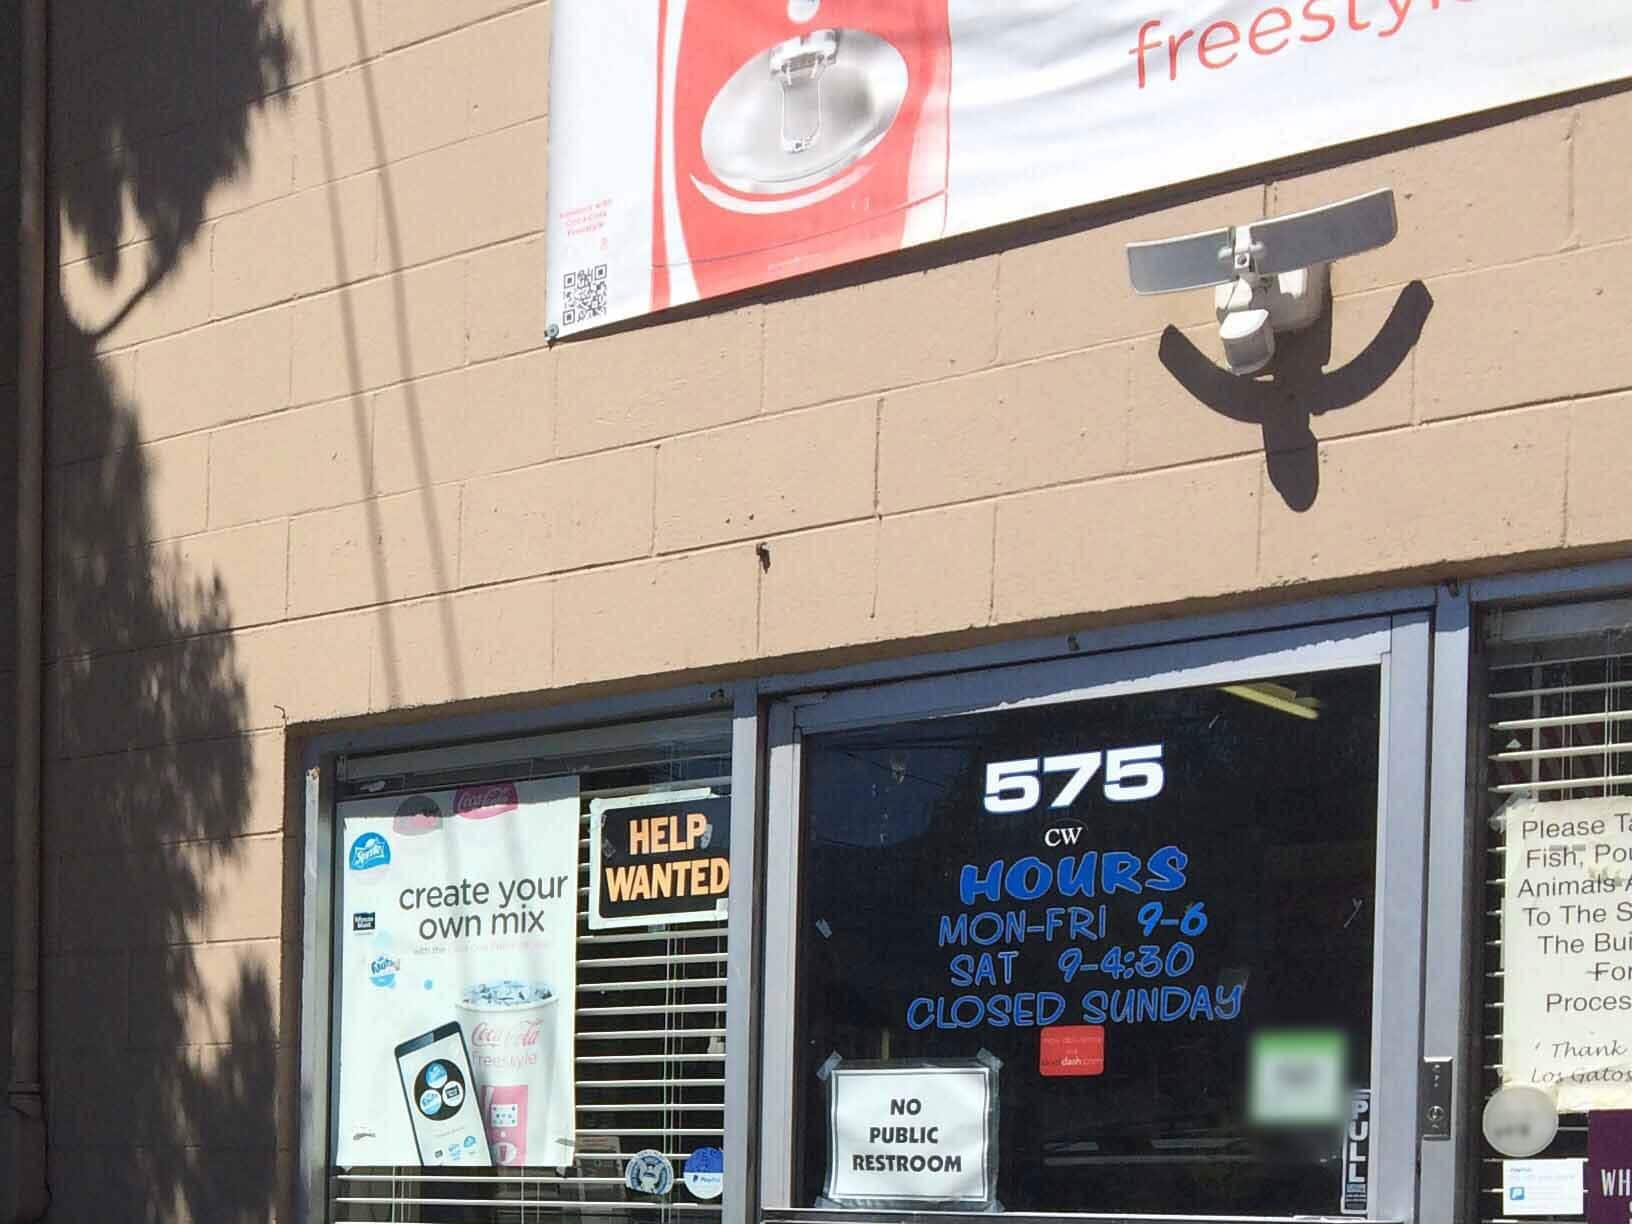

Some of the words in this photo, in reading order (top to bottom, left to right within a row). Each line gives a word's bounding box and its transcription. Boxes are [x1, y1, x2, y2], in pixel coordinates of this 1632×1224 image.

[983, 744, 1165, 813] 575
[629, 813, 706, 856] HELP
[1044, 827, 1082, 847] CW
[1522, 819, 1605, 840] Please
[1526, 847, 1584, 869] Fish,
[605, 858, 731, 902] WANTED
[960, 846, 1189, 905] HOURS
[1518, 875, 1616, 898] Animals
[399, 877, 490, 911] create
[497, 875, 569, 908] your
[419, 914, 482, 941] own
[491, 904, 545, 936] mix
[939, 904, 1107, 947] MON-FRI
[1137, 902, 1208, 937] 9-6
[1522, 906, 1551, 927] To
[1560, 904, 1607, 924] The
[1537, 935, 1585, 956] The
[950, 950, 1020, 987] SAT
[1058, 942, 1195, 983] 9-4:30
[906, 992, 1066, 1031] CLOSED
[1082, 985, 1244, 1025] SUNDAY
[1551, 1039, 1629, 1060] Thank
[890, 1098, 921, 1116] NO
[869, 1126, 939, 1145] PUBLIC
[1348, 1100, 1369, 1183] PULL
[852, 1154, 962, 1173] RESTROOM
